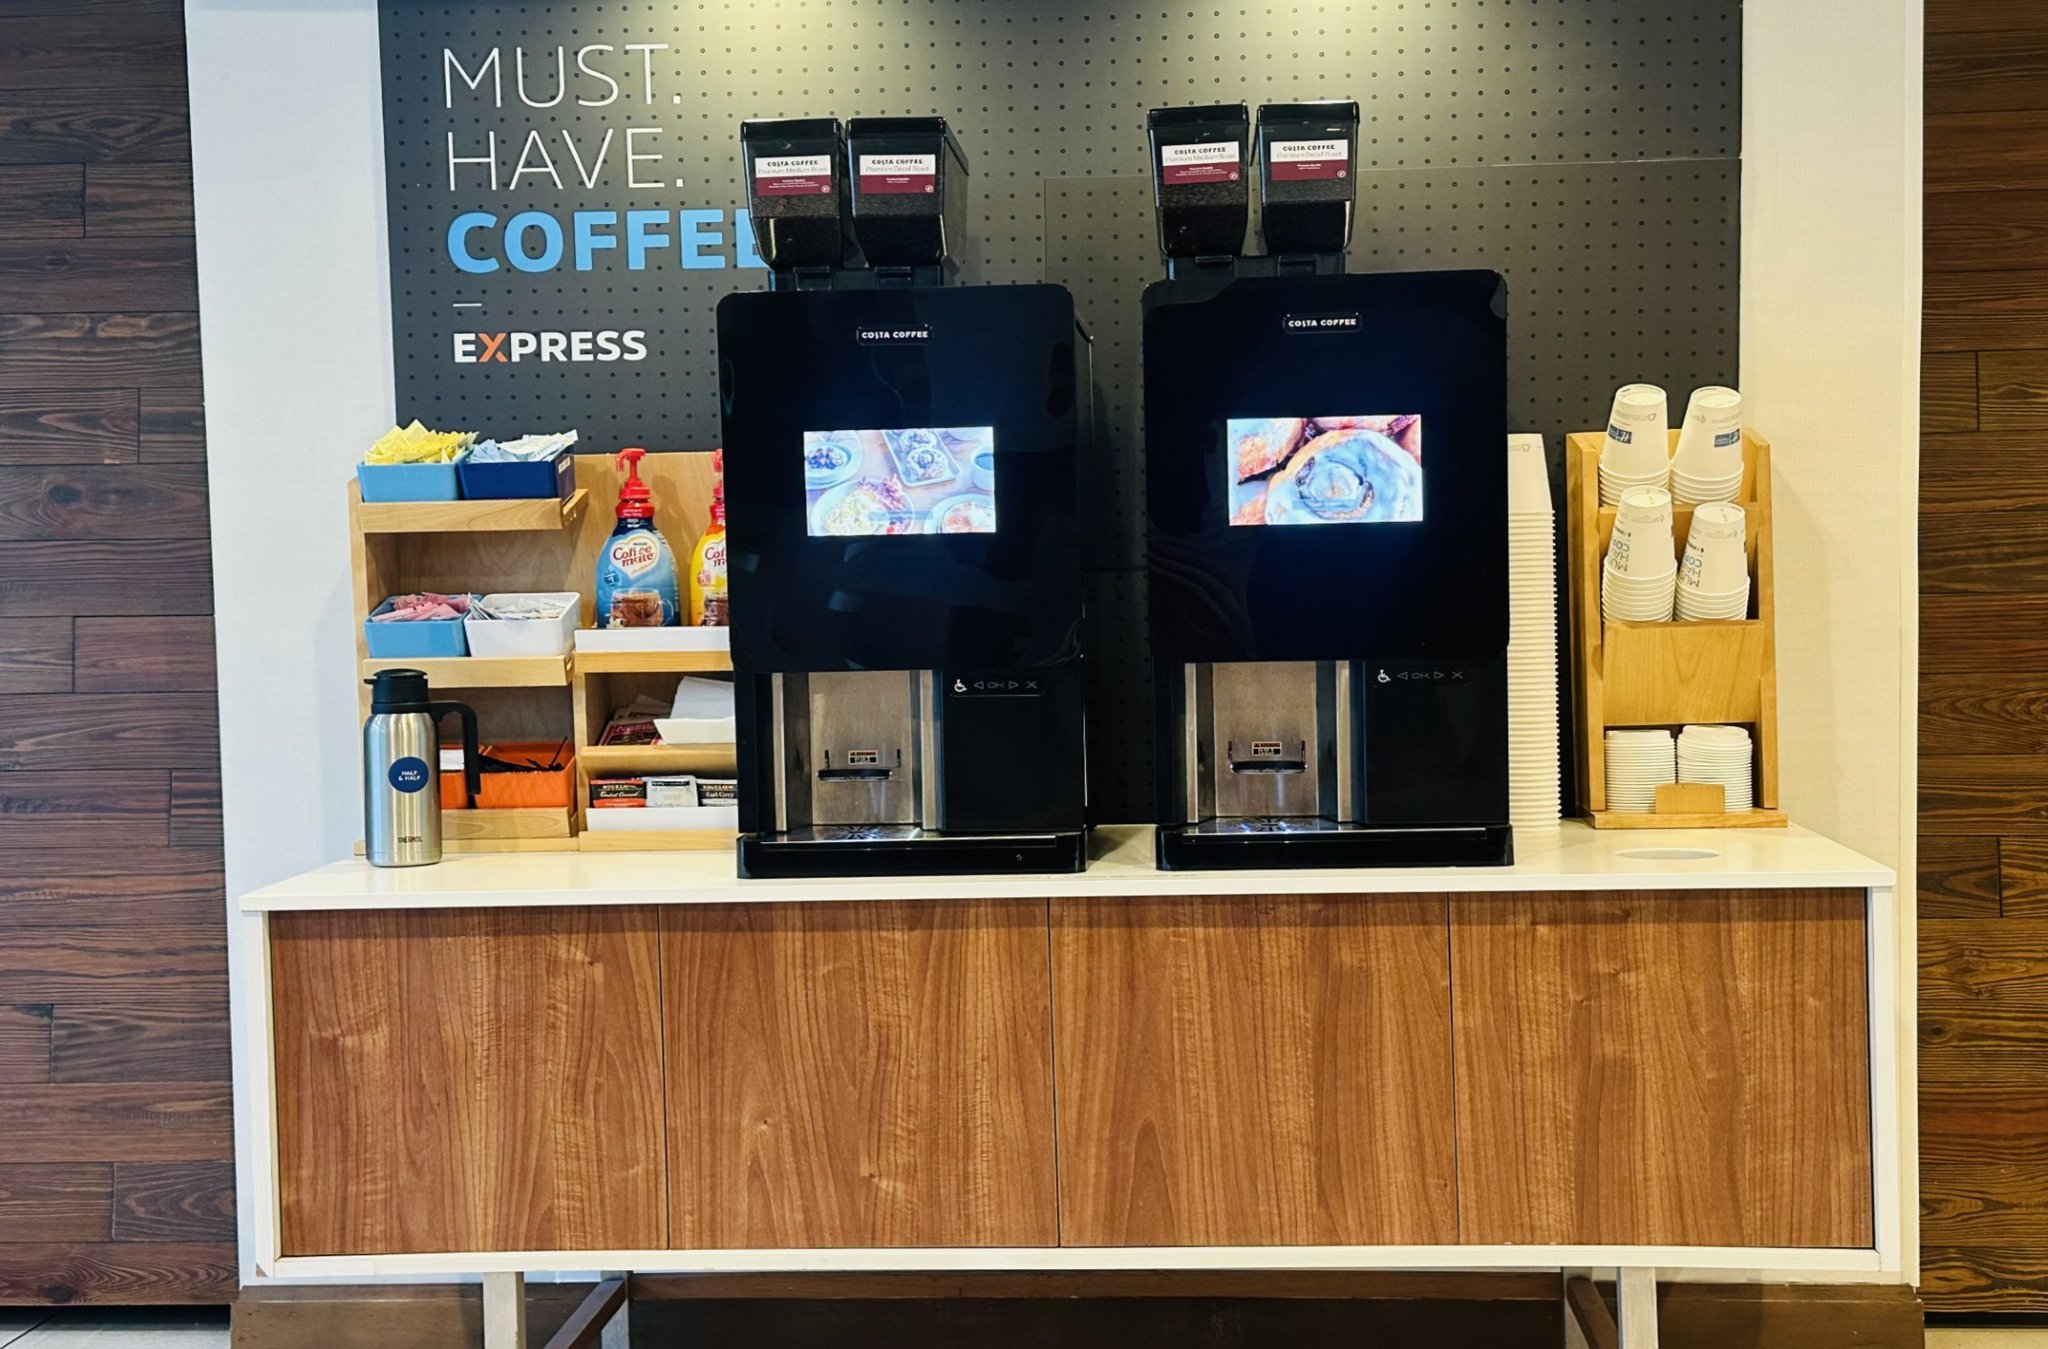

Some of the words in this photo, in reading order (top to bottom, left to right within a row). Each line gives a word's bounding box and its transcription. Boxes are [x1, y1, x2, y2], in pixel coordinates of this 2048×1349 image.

[443, 43, 681, 109] MUST.
[447, 127, 684, 191] HAVE.
[1198, 146, 1227, 154] COFFEE
[1288, 320, 1318, 328] COSTA
[1320, 318, 1357, 326] COFFEE
[861, 331, 890, 340] COSTA
[892, 330, 929, 338] COFFEE
[453, 330, 648, 363] EXPRESS
